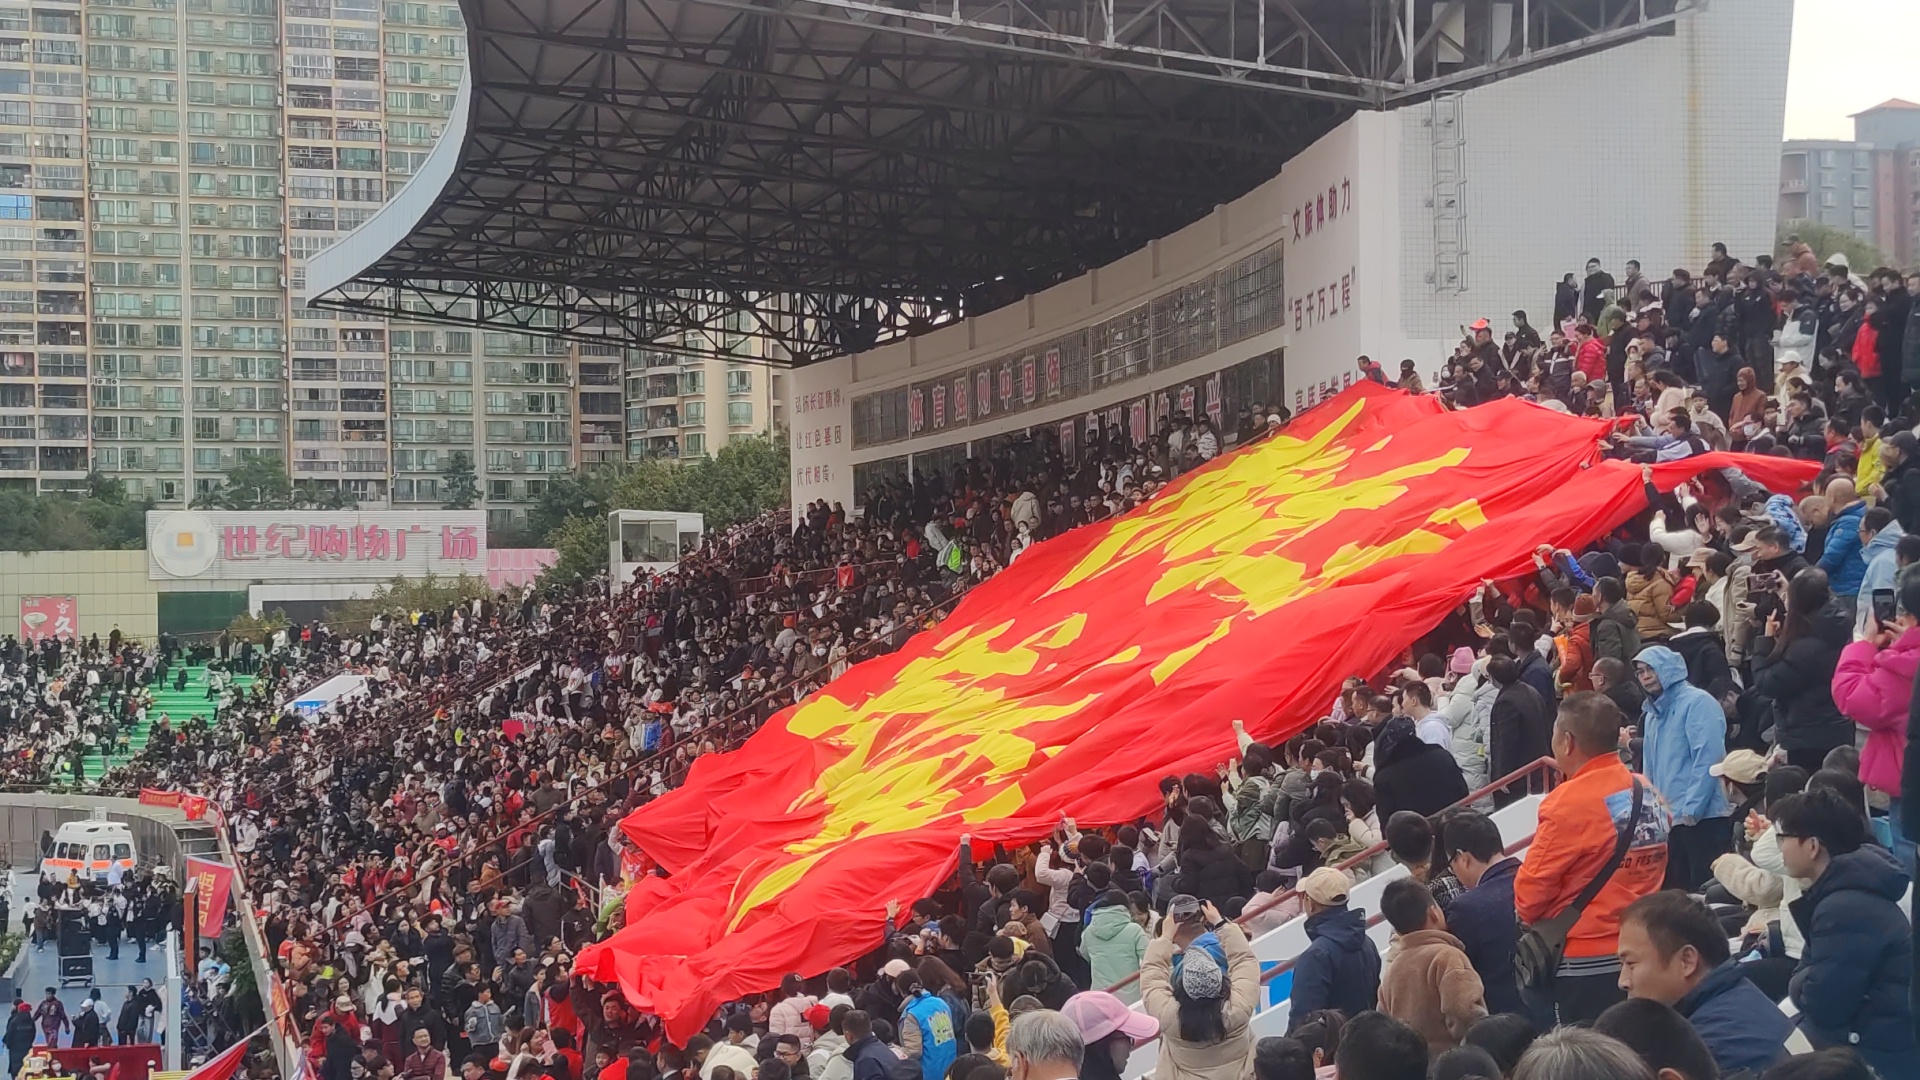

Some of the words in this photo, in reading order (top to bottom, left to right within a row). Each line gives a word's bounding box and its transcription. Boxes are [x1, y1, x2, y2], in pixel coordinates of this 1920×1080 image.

[1292, 176, 1351, 244] 文旅体助力
[910, 348, 1061, 432] 体育强则中国强
[222, 523, 478, 561] 世纪购物广场
